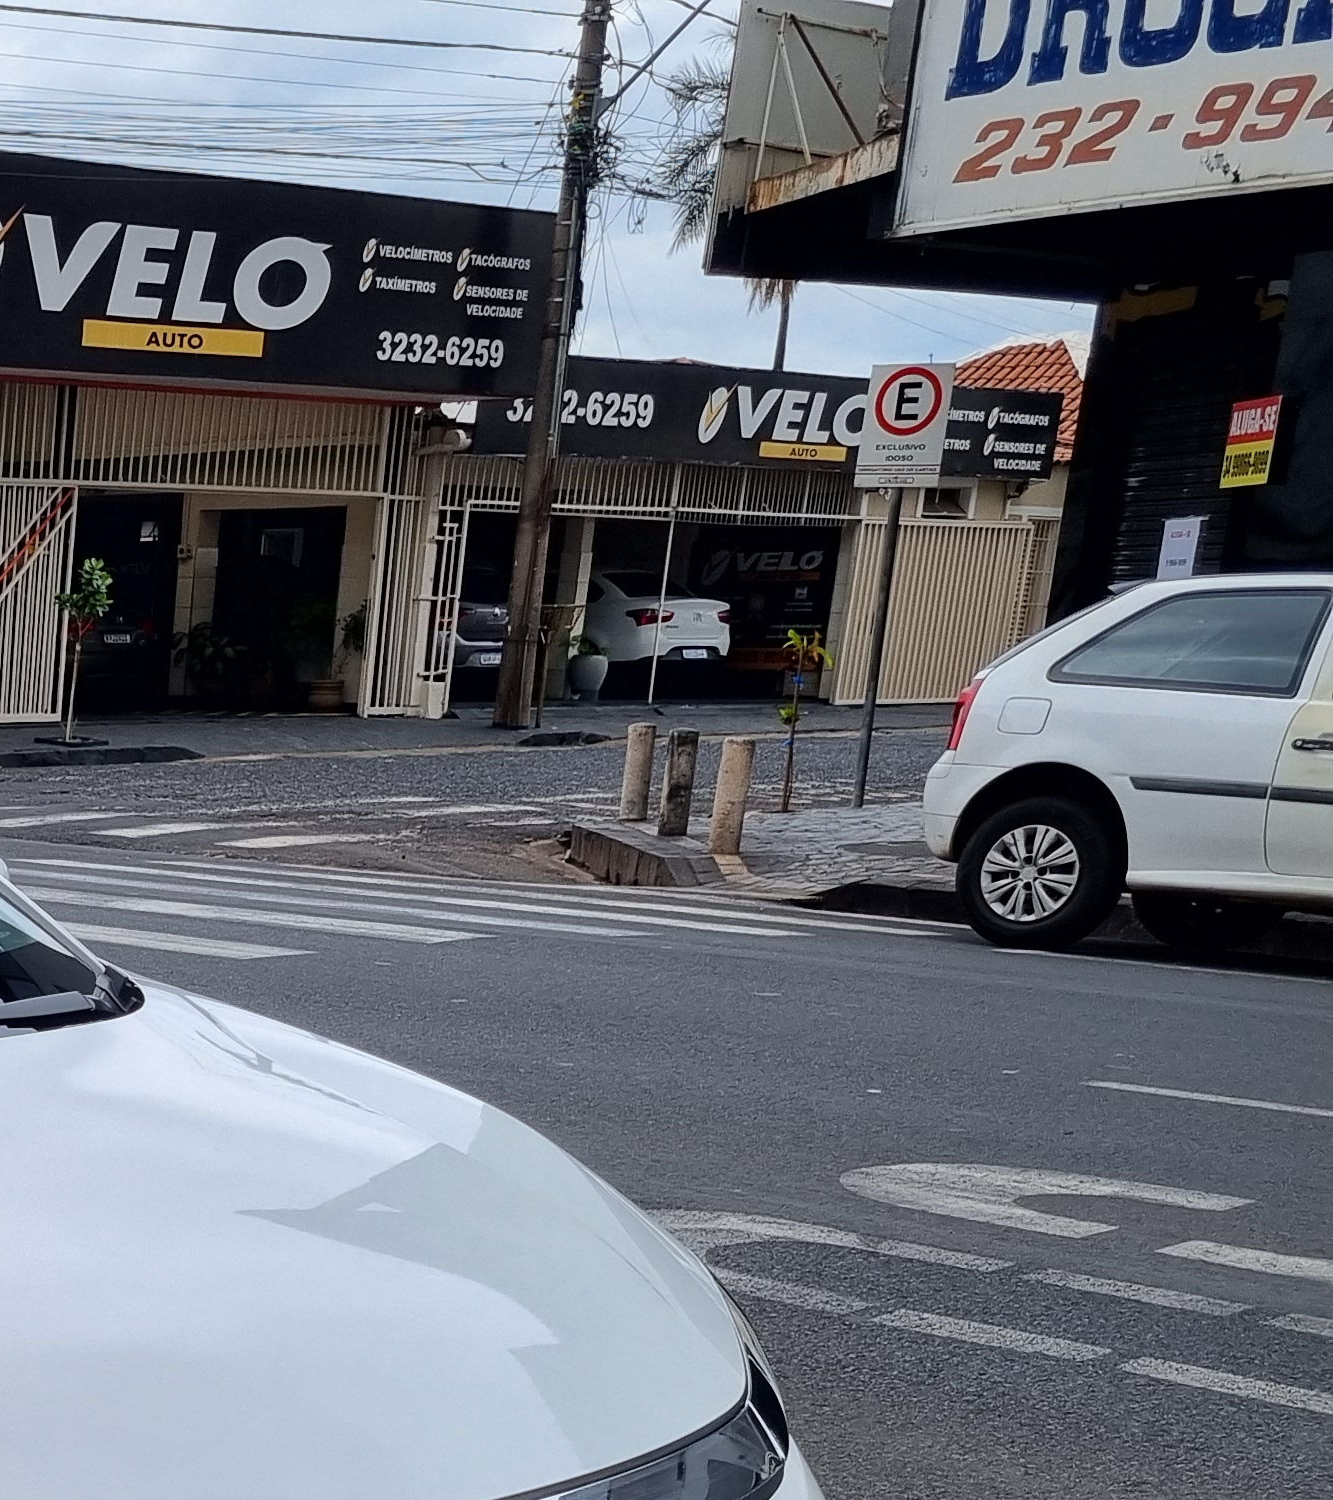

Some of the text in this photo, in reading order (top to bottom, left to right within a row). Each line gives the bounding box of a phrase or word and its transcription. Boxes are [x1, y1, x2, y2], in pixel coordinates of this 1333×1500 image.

[944, 0, 1333, 101] DRO
[379, 244, 531, 271] VELOCÍMETROS TACÓGRAFOS
[23, 212, 333, 331] VELO
[375, 275, 529, 302] TAXÍMETROS SENSORES DE
[466, 303, 524, 319] VELOCIDADE
[146, 331, 204, 350] AUTO
[376, 330, 504, 368] 3232-6259
[506, 389, 654, 428] 32-6259
[894, 381, 923, 421] E
[999, 411, 1050, 427] TACÓGRAFOS
[1229, 405, 1278, 436] ALUGA-SE
[789, 447, 818, 458] AUTO
[875, 443, 926, 451] EXCLUSIVO
[993, 441, 1034, 454] SENSORES
[1035, 444, 1046, 454] DE
[993, 458, 1042, 471] VELOCIDADE
[736, 551, 825, 571] VELO
